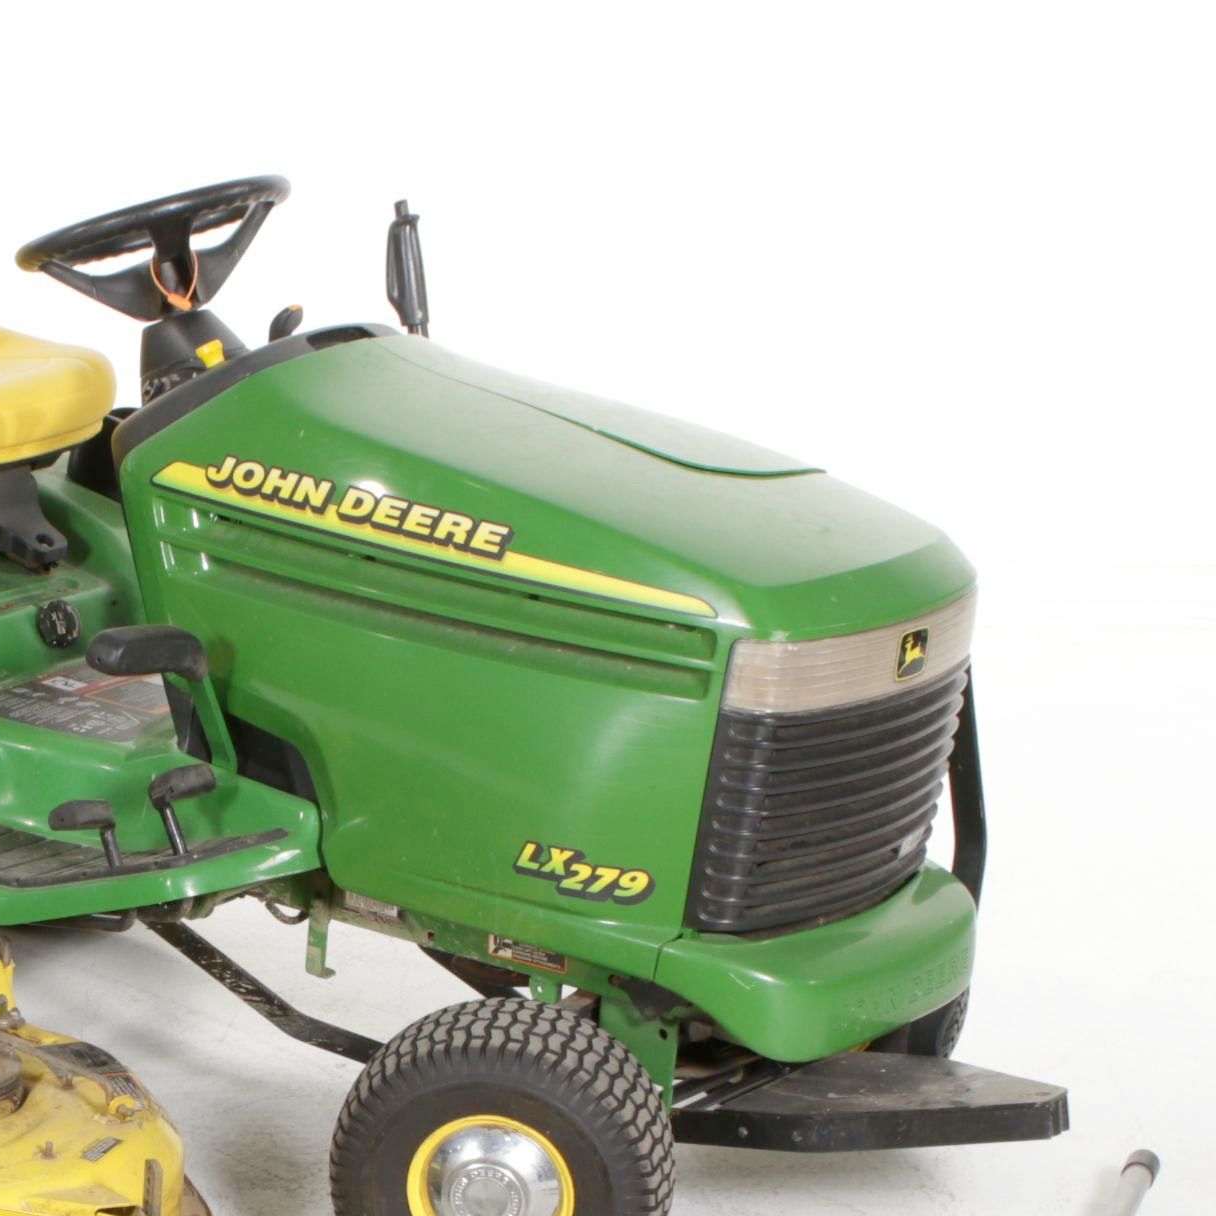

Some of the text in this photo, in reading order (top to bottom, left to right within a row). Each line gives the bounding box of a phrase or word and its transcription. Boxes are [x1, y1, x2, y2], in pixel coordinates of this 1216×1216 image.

[205, 456, 512, 560] JOHN DEERE
[513, 840, 655, 905] LX279
